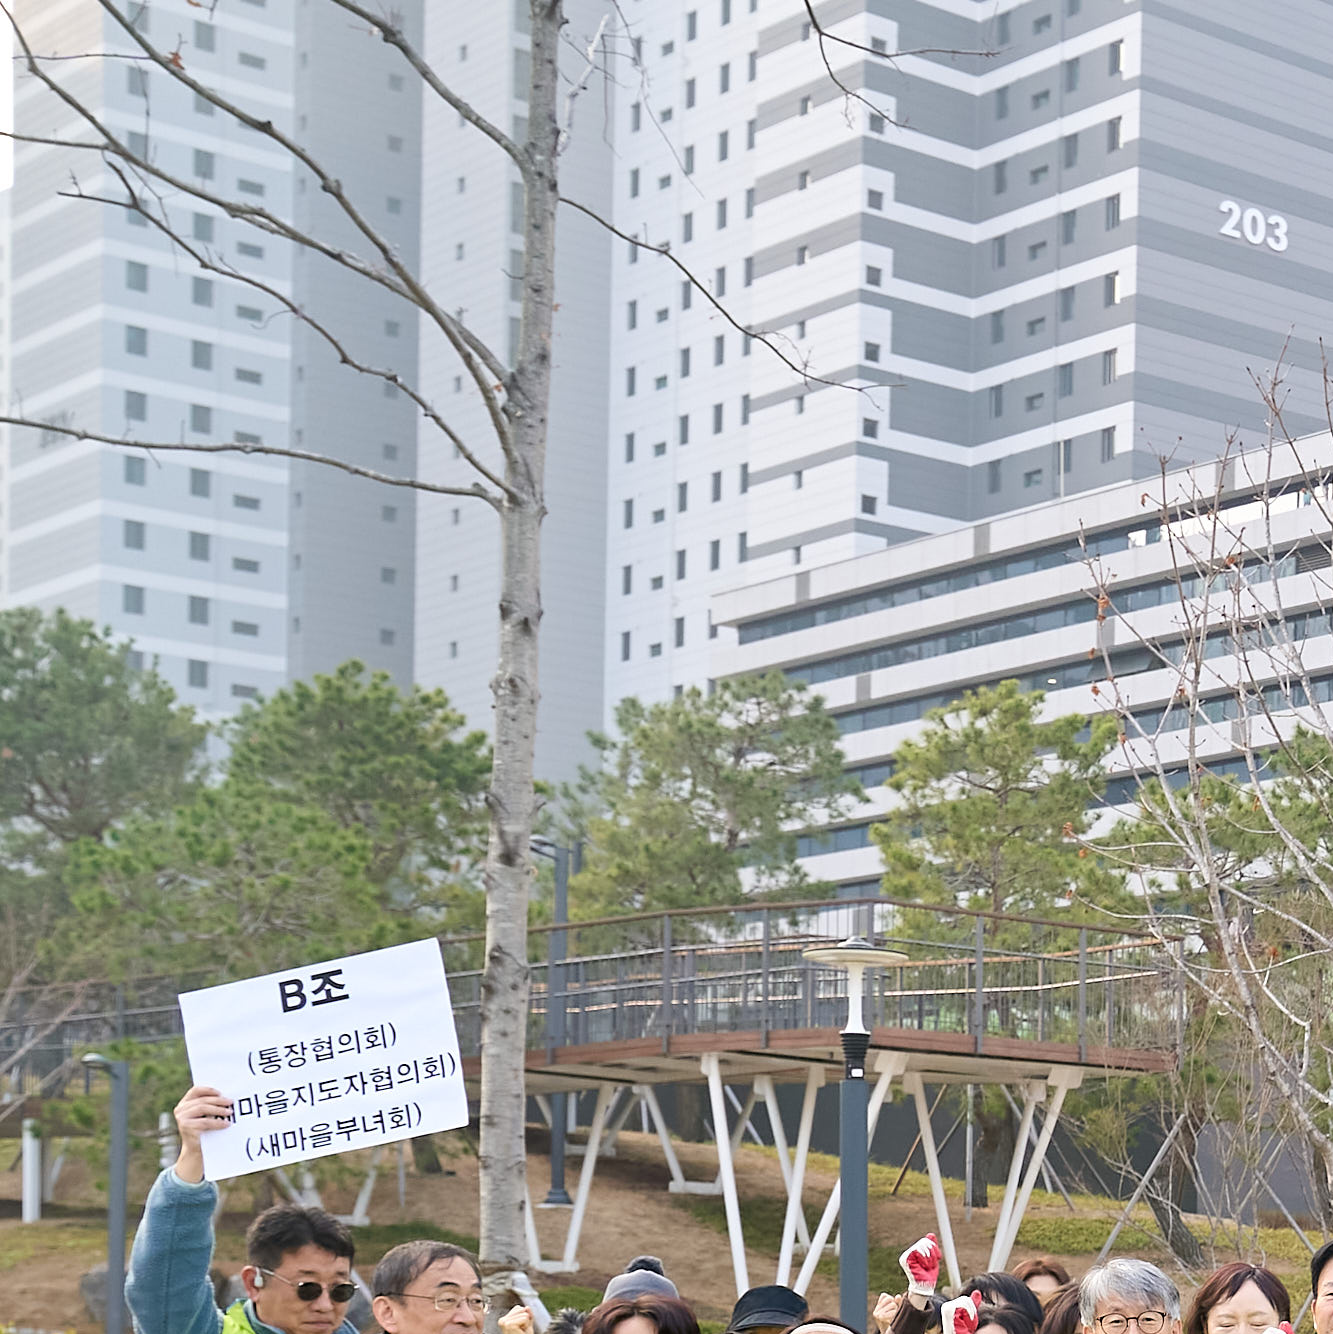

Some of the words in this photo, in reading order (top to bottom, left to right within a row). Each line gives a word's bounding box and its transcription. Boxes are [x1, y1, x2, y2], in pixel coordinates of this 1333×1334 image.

[1219, 200, 1288, 251] 203
[279, 969, 349, 1014] B조
[248, 1021, 398, 1079] (통장협의회)
[244, 1104, 424, 1163] (새마을부녀회)
